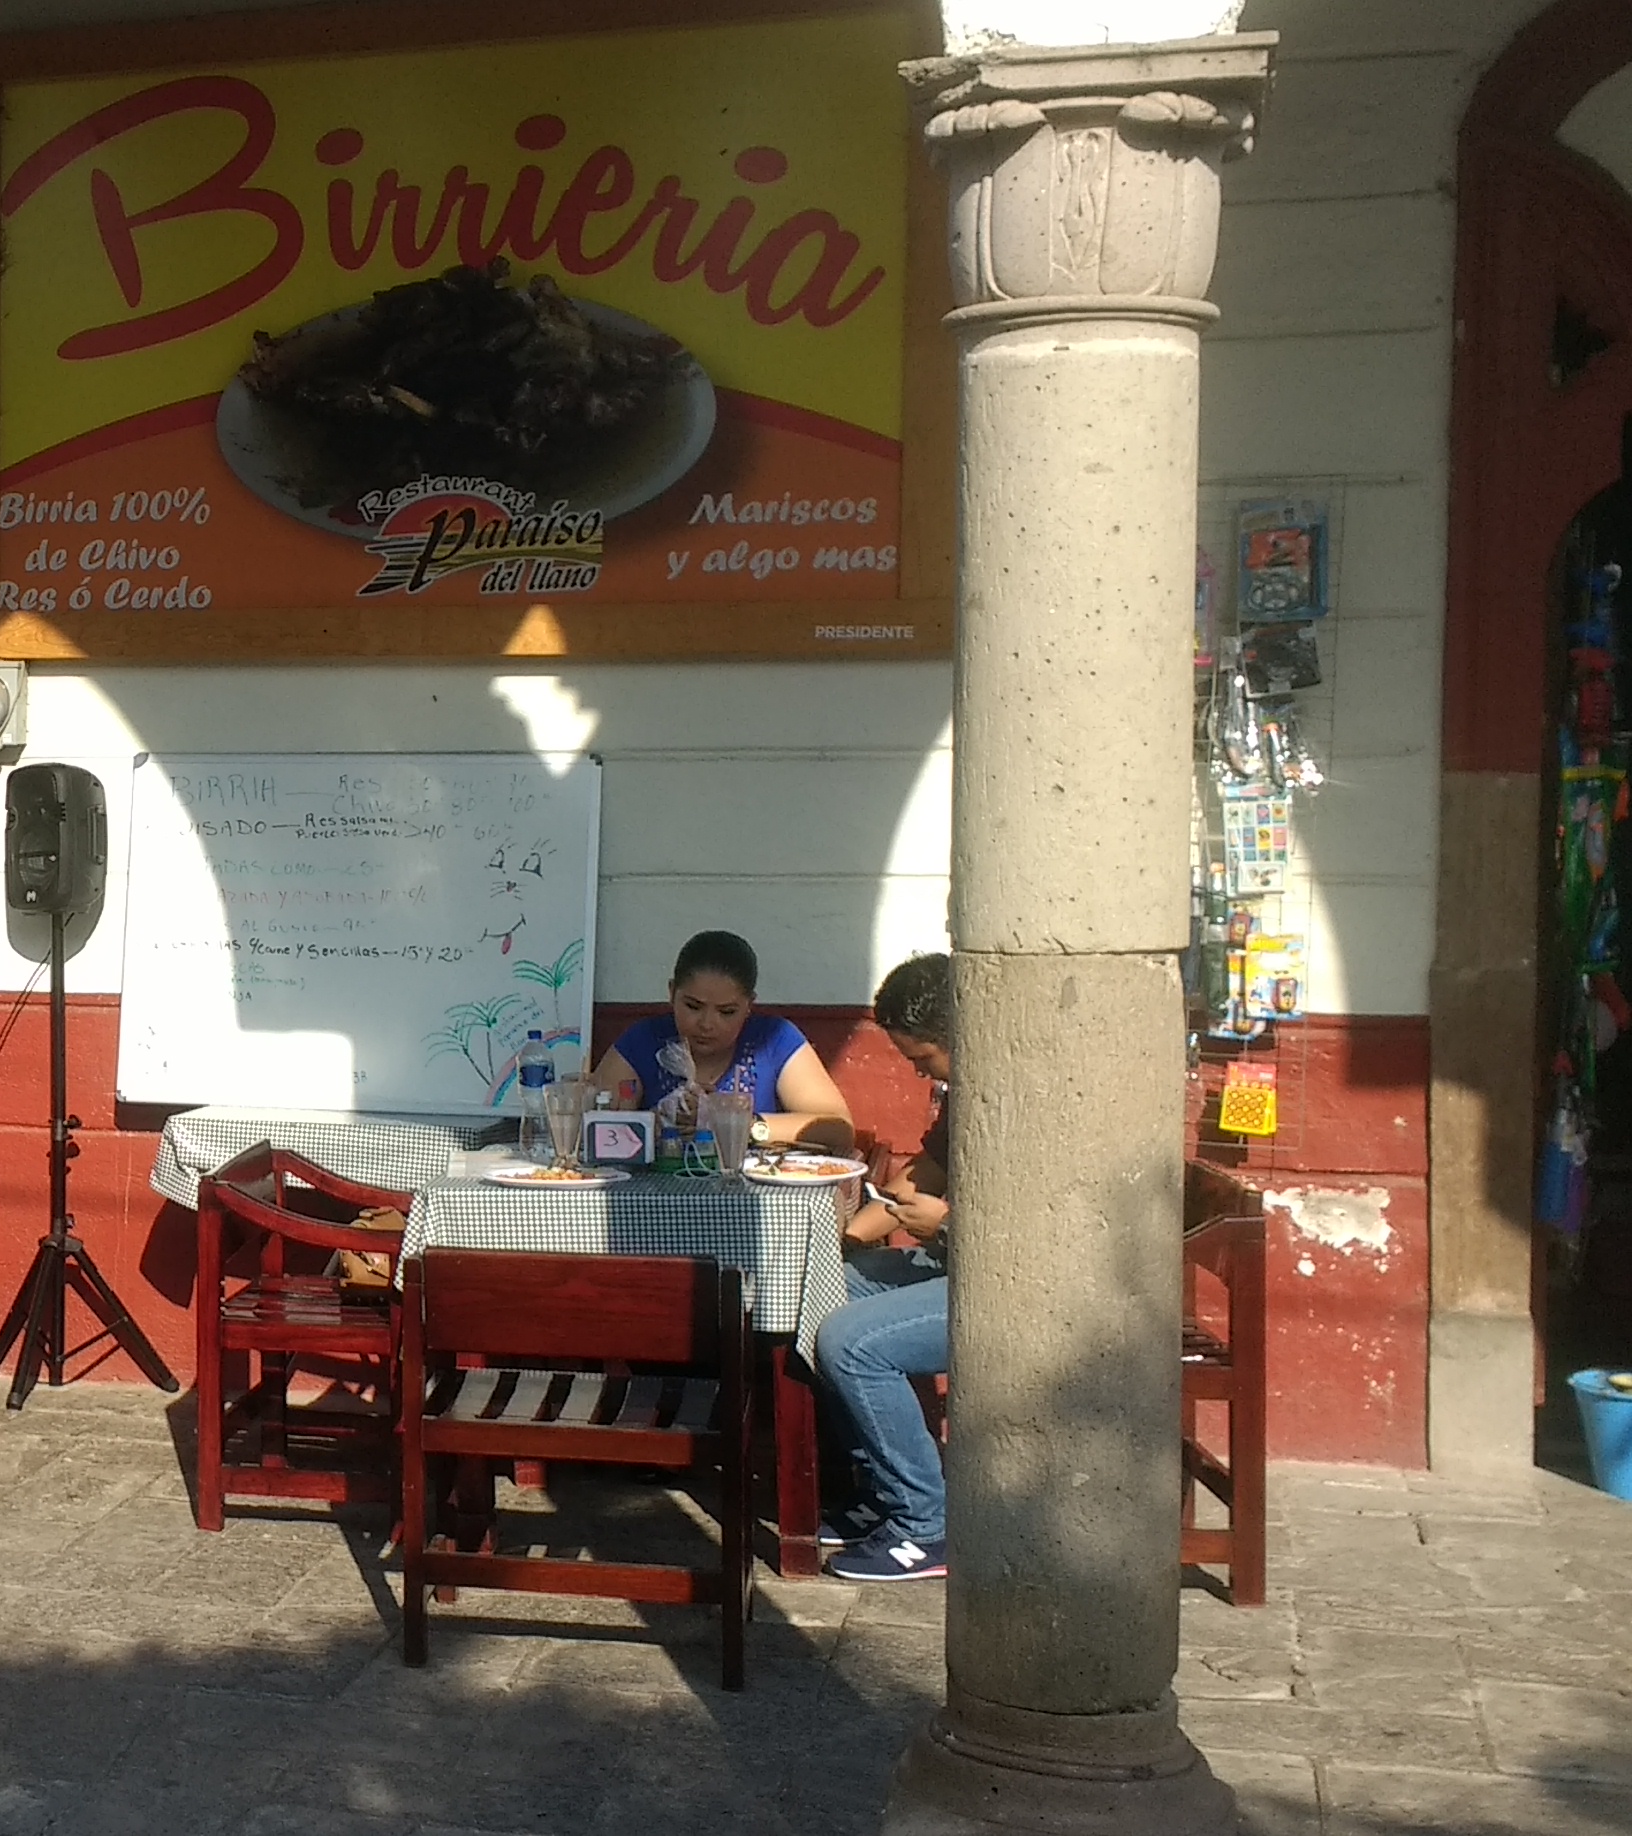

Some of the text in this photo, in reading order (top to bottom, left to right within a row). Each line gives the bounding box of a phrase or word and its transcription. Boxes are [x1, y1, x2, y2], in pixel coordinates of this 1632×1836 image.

[1, 74, 886, 361] Birrieria
[109, 487, 211, 525] 100%
[358, 473, 536, 523] Restaurant
[688, 491, 878, 526] Mariscos
[24, 538, 180, 572] de Chivo
[667, 540, 897, 581] y algo mas
[69, 576, 92, 610] ó
[104, 575, 213, 610] Cerdo
[479, 558, 599, 593] del llano
[814, 625, 914, 639] PRESIDENTE
[305, 813, 336, 828] Res
[889, 1540, 927, 1568] N
